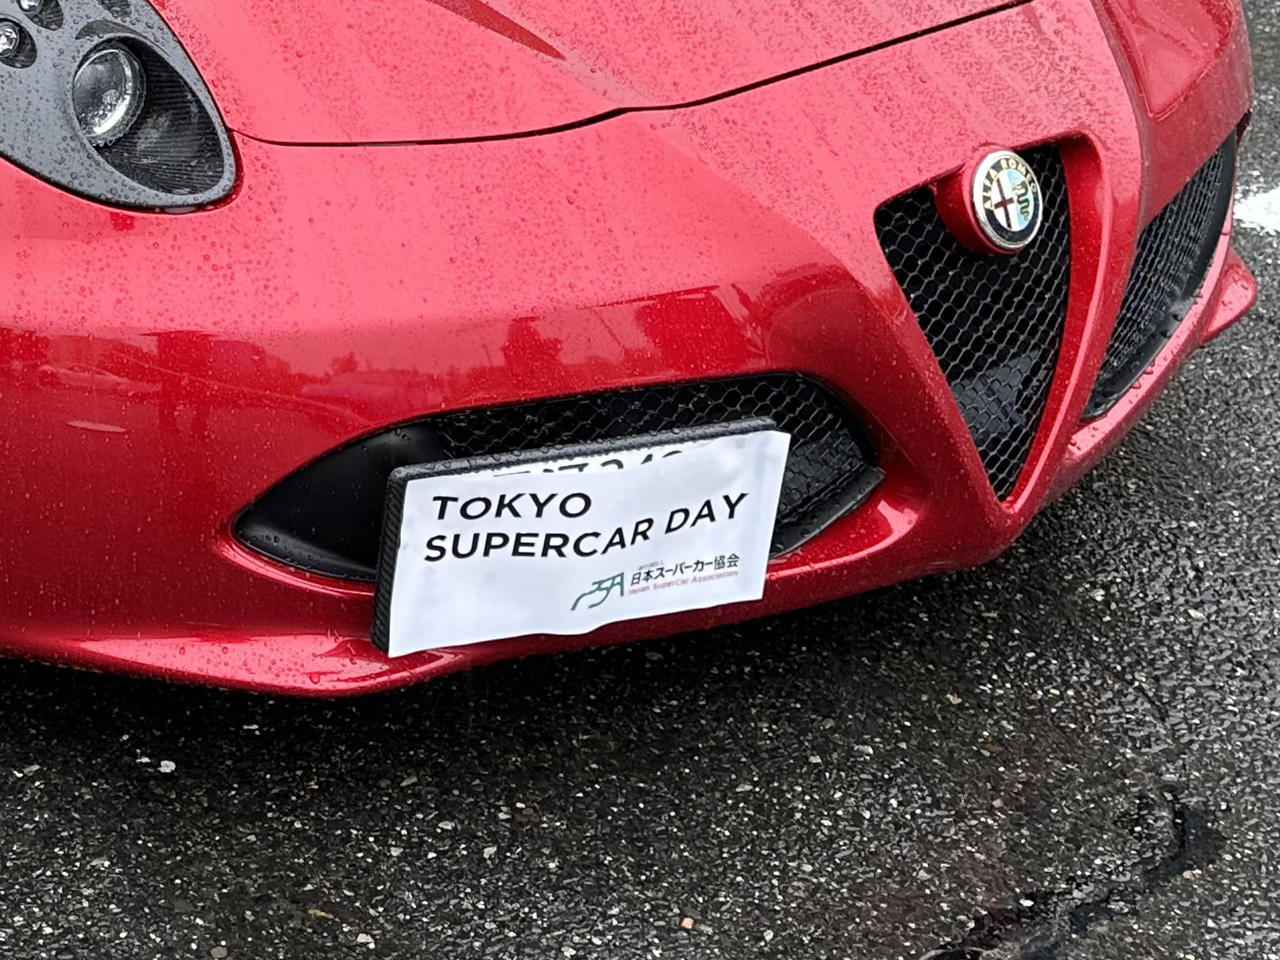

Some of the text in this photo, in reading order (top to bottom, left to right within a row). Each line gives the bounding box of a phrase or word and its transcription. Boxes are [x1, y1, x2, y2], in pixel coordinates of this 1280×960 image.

[1000, 159, 1037, 193] ROMEO
[431, 492, 592, 521] TOKYO
[424, 492, 749, 562] SUPERCAR DAY
[630, 553, 740, 586] 日本スーパーカー協会
